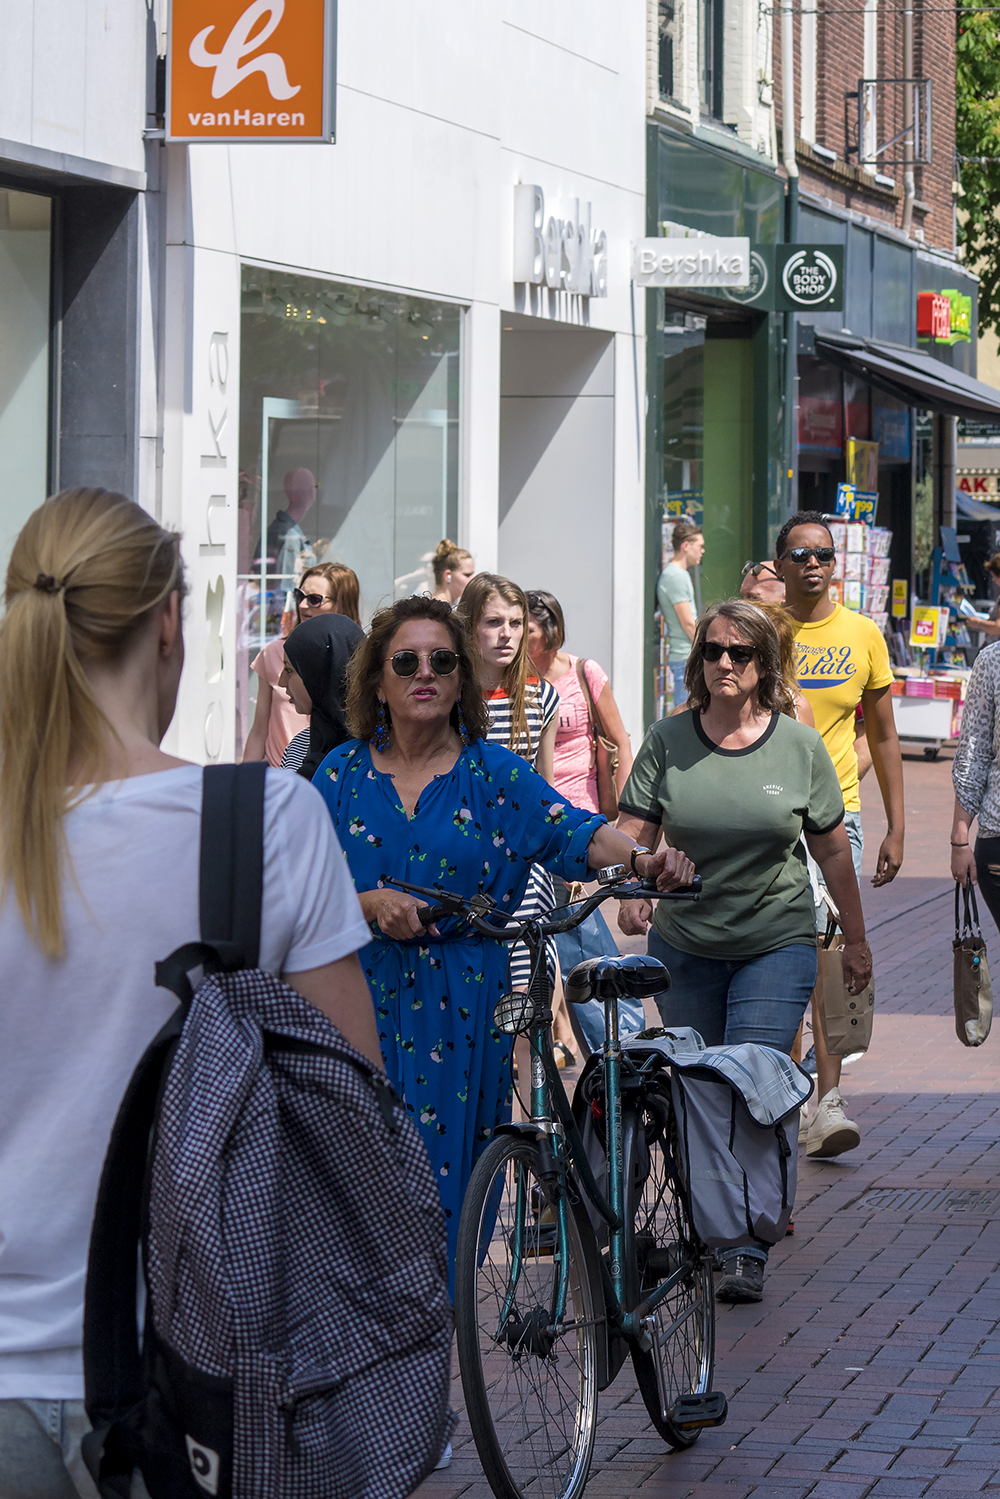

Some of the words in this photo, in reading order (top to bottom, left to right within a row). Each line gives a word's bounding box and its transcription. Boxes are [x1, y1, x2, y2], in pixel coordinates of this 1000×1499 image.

[187, 109, 306, 127] vanHaren
[639, 249, 745, 276] Bershka
[799, 266, 820, 276] THE
[793, 275, 827, 285] BODY
[794, 285, 826, 295] SHOP
[199, 331, 230, 765] ershka
